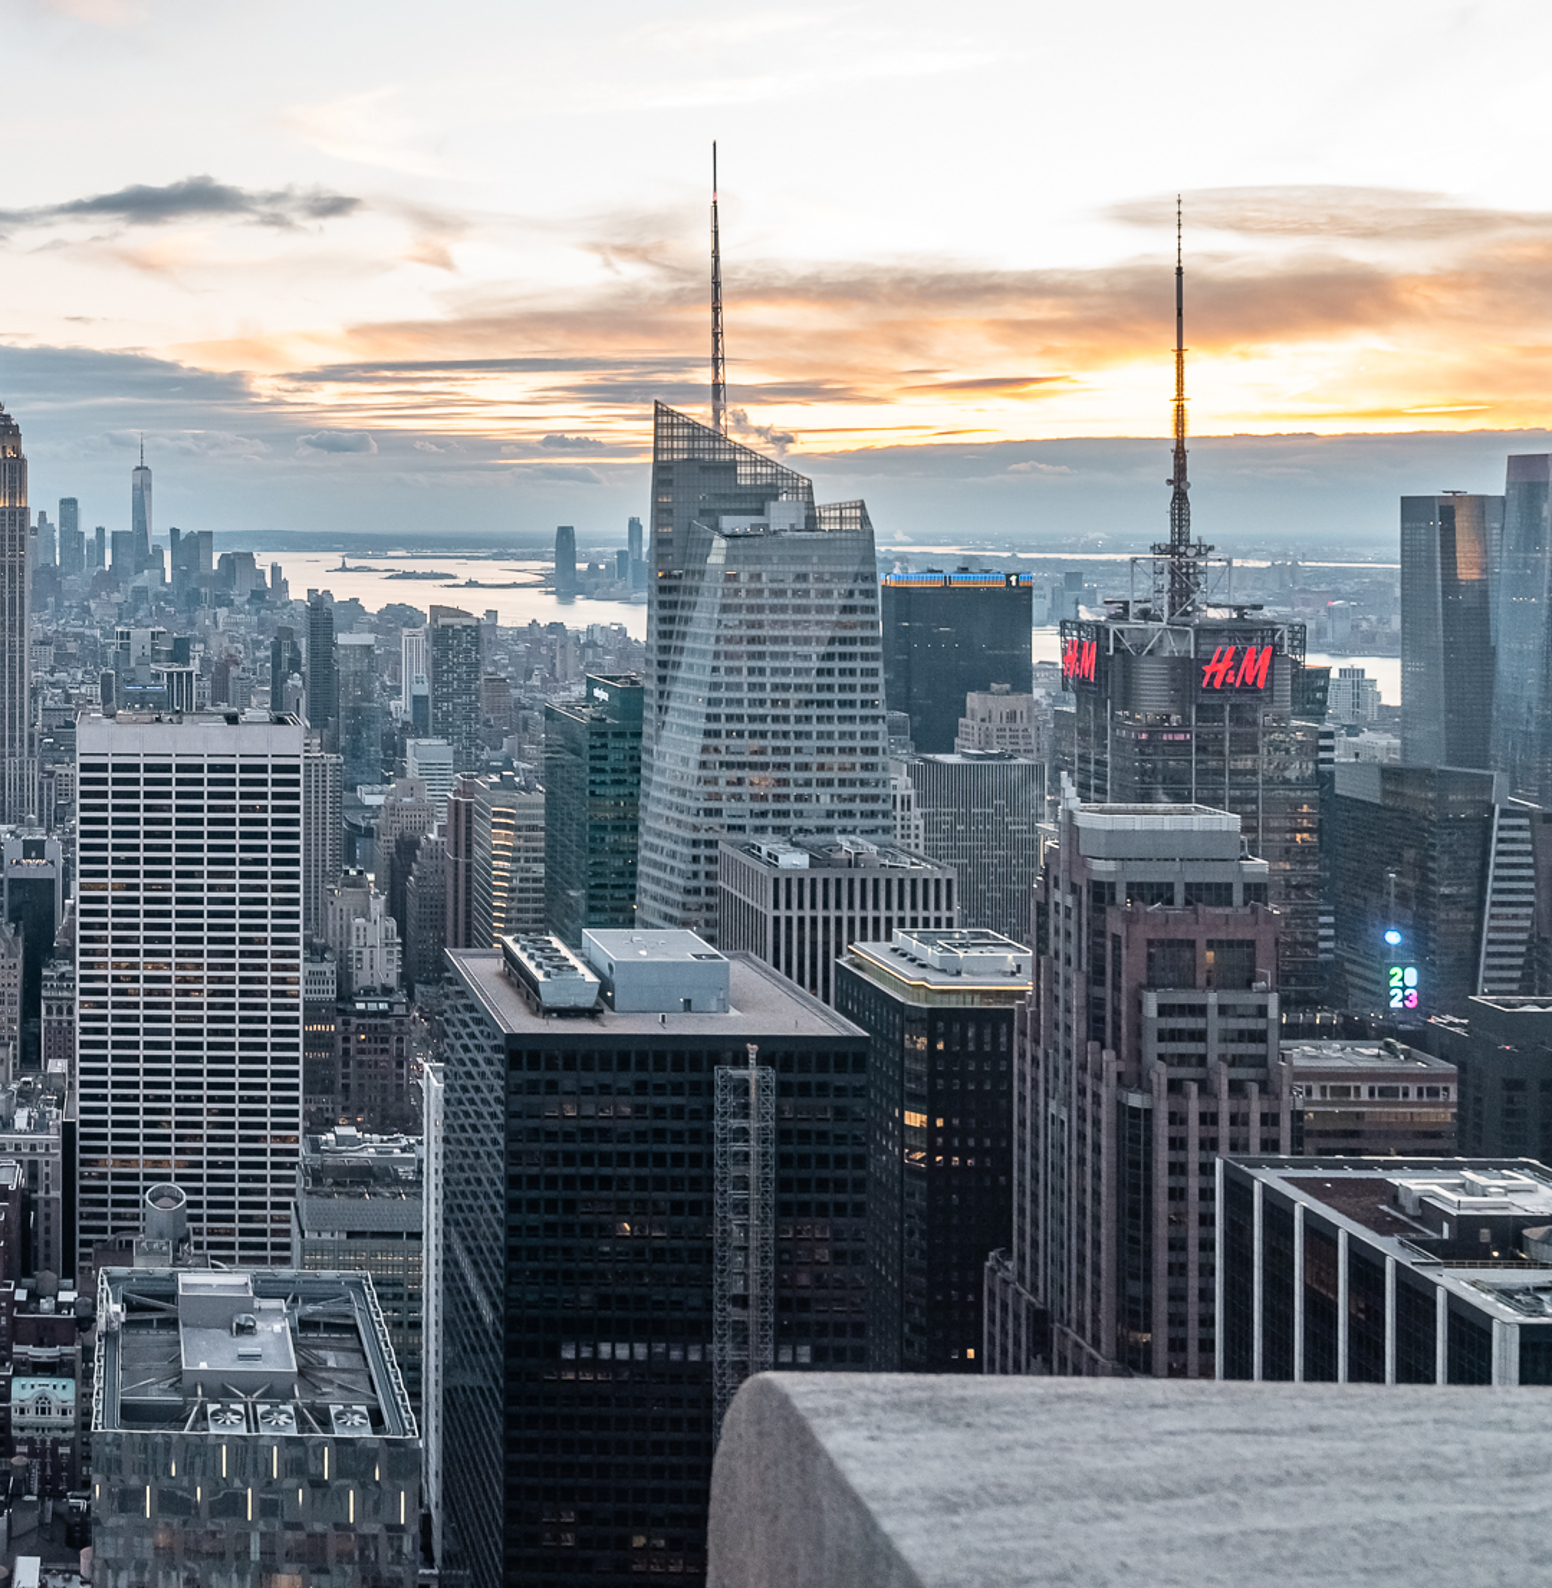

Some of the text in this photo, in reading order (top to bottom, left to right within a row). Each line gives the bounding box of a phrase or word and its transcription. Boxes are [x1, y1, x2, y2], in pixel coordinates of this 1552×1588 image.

[1063, 639, 1096, 682] H&M
[1202, 645, 1273, 689] H&M
[1389, 966, 1418, 987] 20
[1389, 988, 1418, 1008] 23
